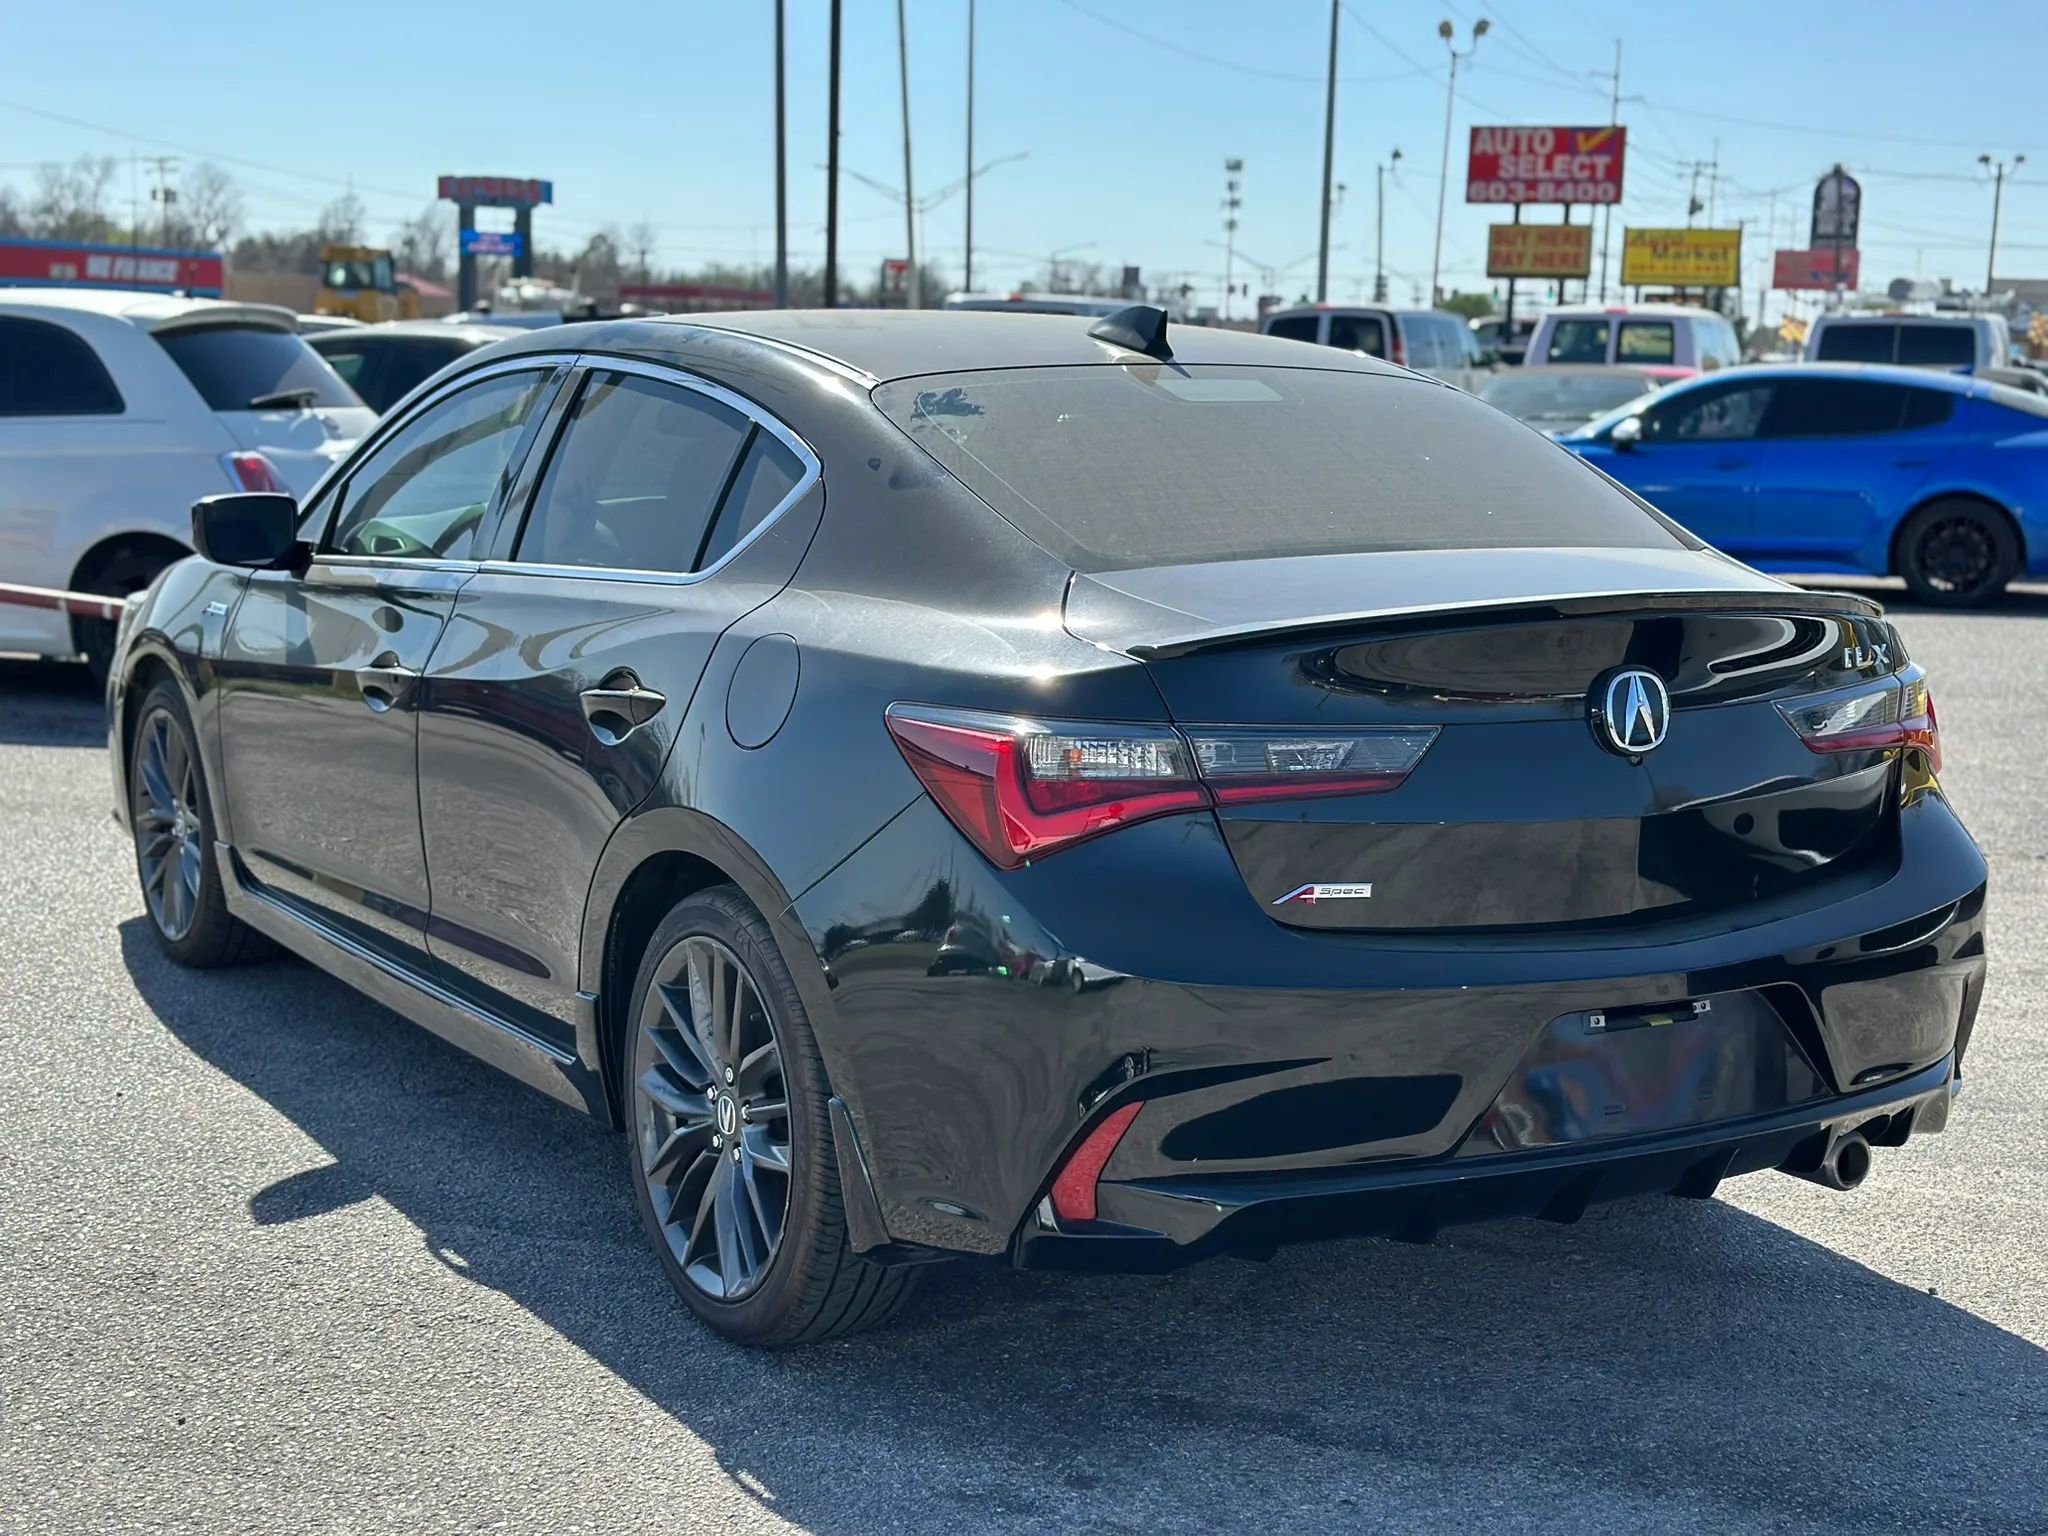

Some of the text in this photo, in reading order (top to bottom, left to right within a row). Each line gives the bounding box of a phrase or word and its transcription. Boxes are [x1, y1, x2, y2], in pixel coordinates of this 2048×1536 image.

[1474, 128, 1555, 155] AUTO
[1497, 154, 1613, 180] SELECT
[1468, 180, 1617, 201] 603-8400
